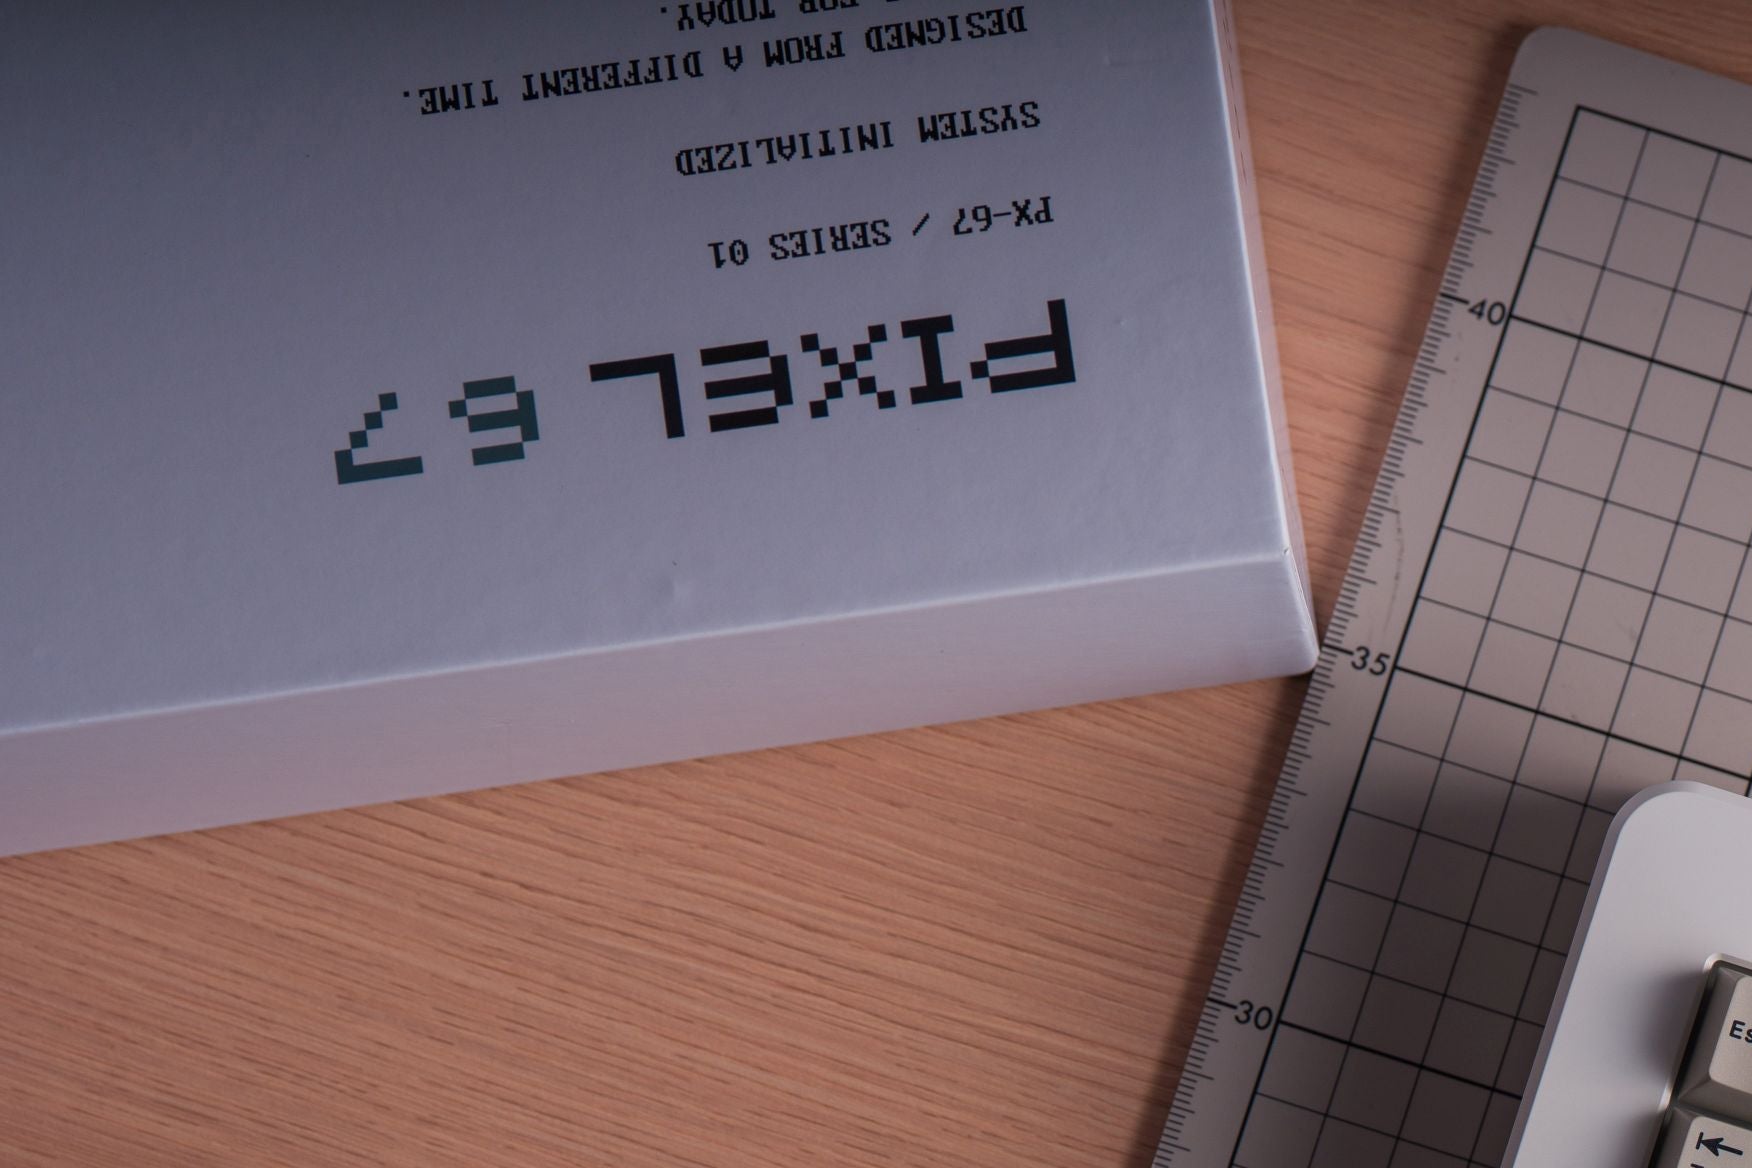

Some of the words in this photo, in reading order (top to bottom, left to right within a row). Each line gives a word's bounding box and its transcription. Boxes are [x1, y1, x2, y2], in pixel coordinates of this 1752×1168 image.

[864, 5, 1028, 53] DESIGNED
[722, 45, 744, 72] A
[763, 30, 846, 68] FROM
[522, 50, 704, 102] DIFFERENT
[403, 79, 499, 116] TIME.
[917, 101, 1041, 143] SYSTEM
[674, 121, 894, 177] INITIALIZED
[912, 213, 930, 236] /
[953, 195, 1054, 236] PX-67
[707, 239, 750, 269] 01
[768, 219, 892, 261] SERIES
[1467, 299, 1507, 326] 40
[588, 298, 1077, 439] PIXEL
[334, 375, 540, 485] 67
[1351, 646, 1390, 676] 35
[1234, 1000, 1274, 1031] 30
